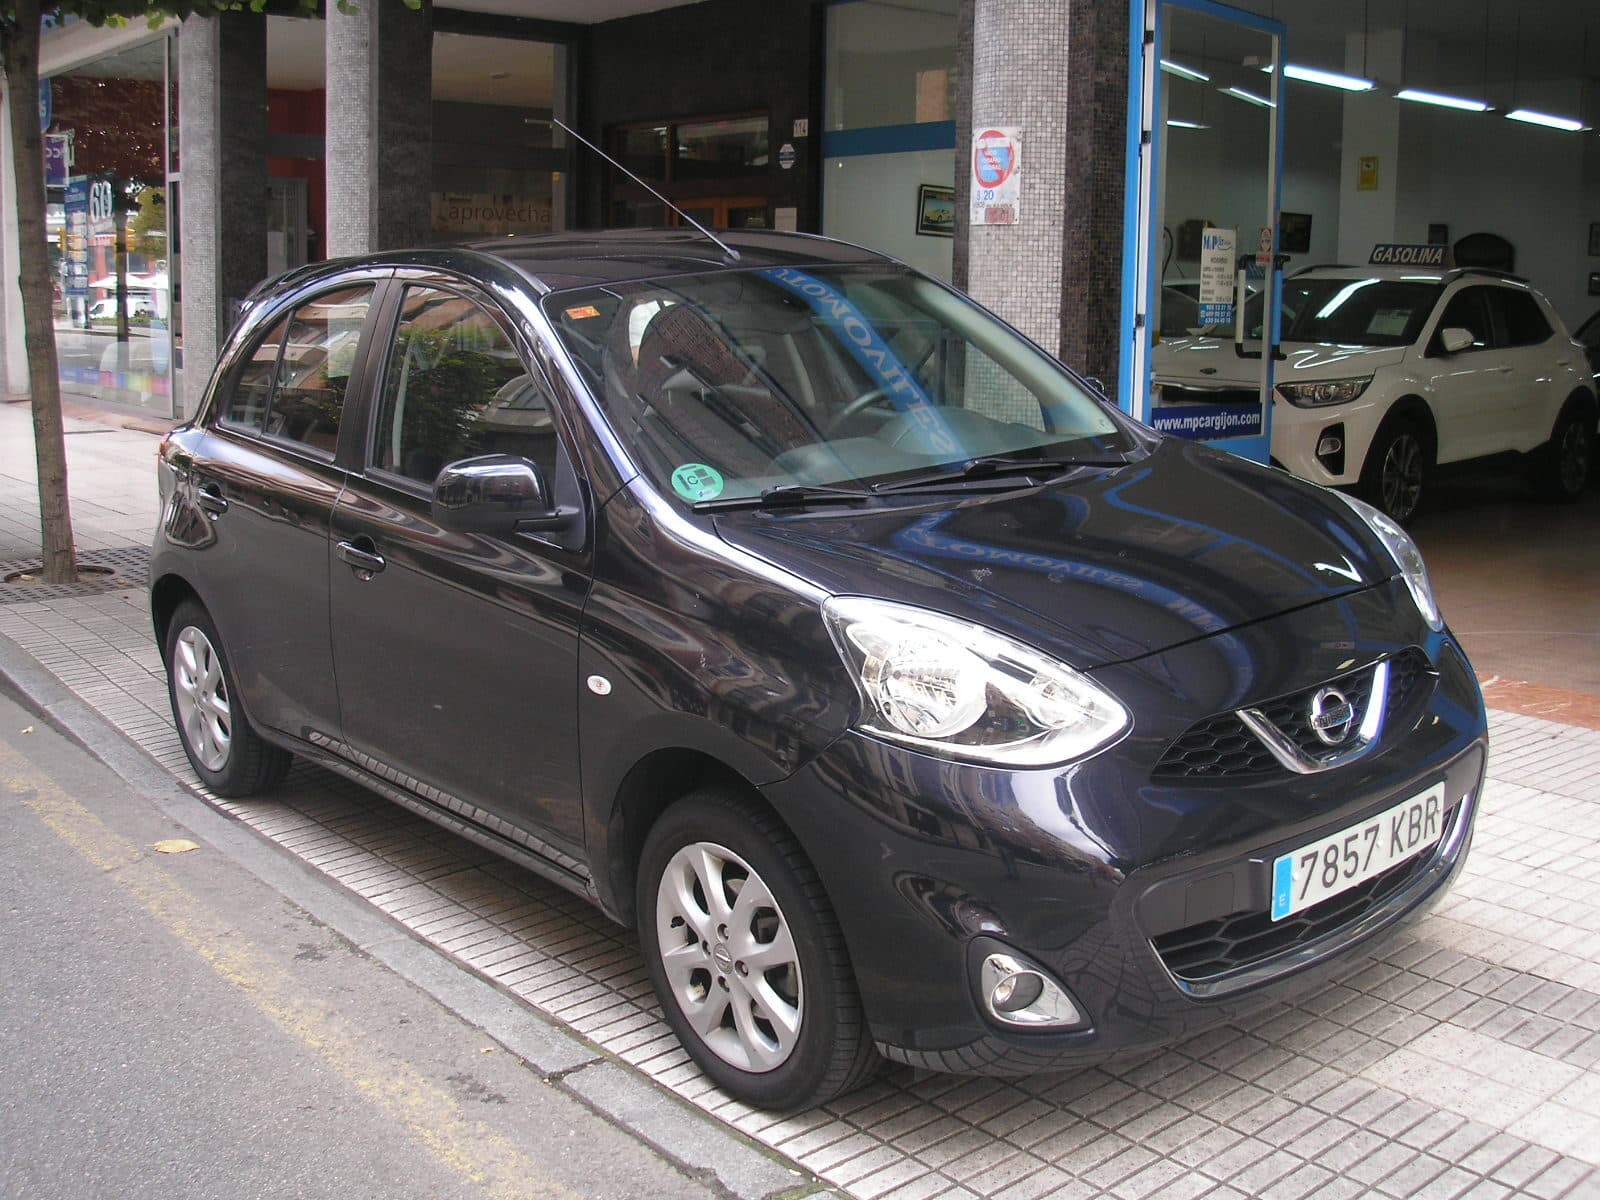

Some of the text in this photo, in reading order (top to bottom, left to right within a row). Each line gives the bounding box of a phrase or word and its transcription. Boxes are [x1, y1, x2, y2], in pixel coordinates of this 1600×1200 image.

[983, 190, 994, 200] 20
[449, 204, 551, 224] aprovecha
[1373, 246, 1443, 264] GASOLINA
[1154, 412, 1260, 431] www.mpcargijon.com
[1300, 822, 1380, 900] 7857
[1389, 795, 1440, 858] KBR
